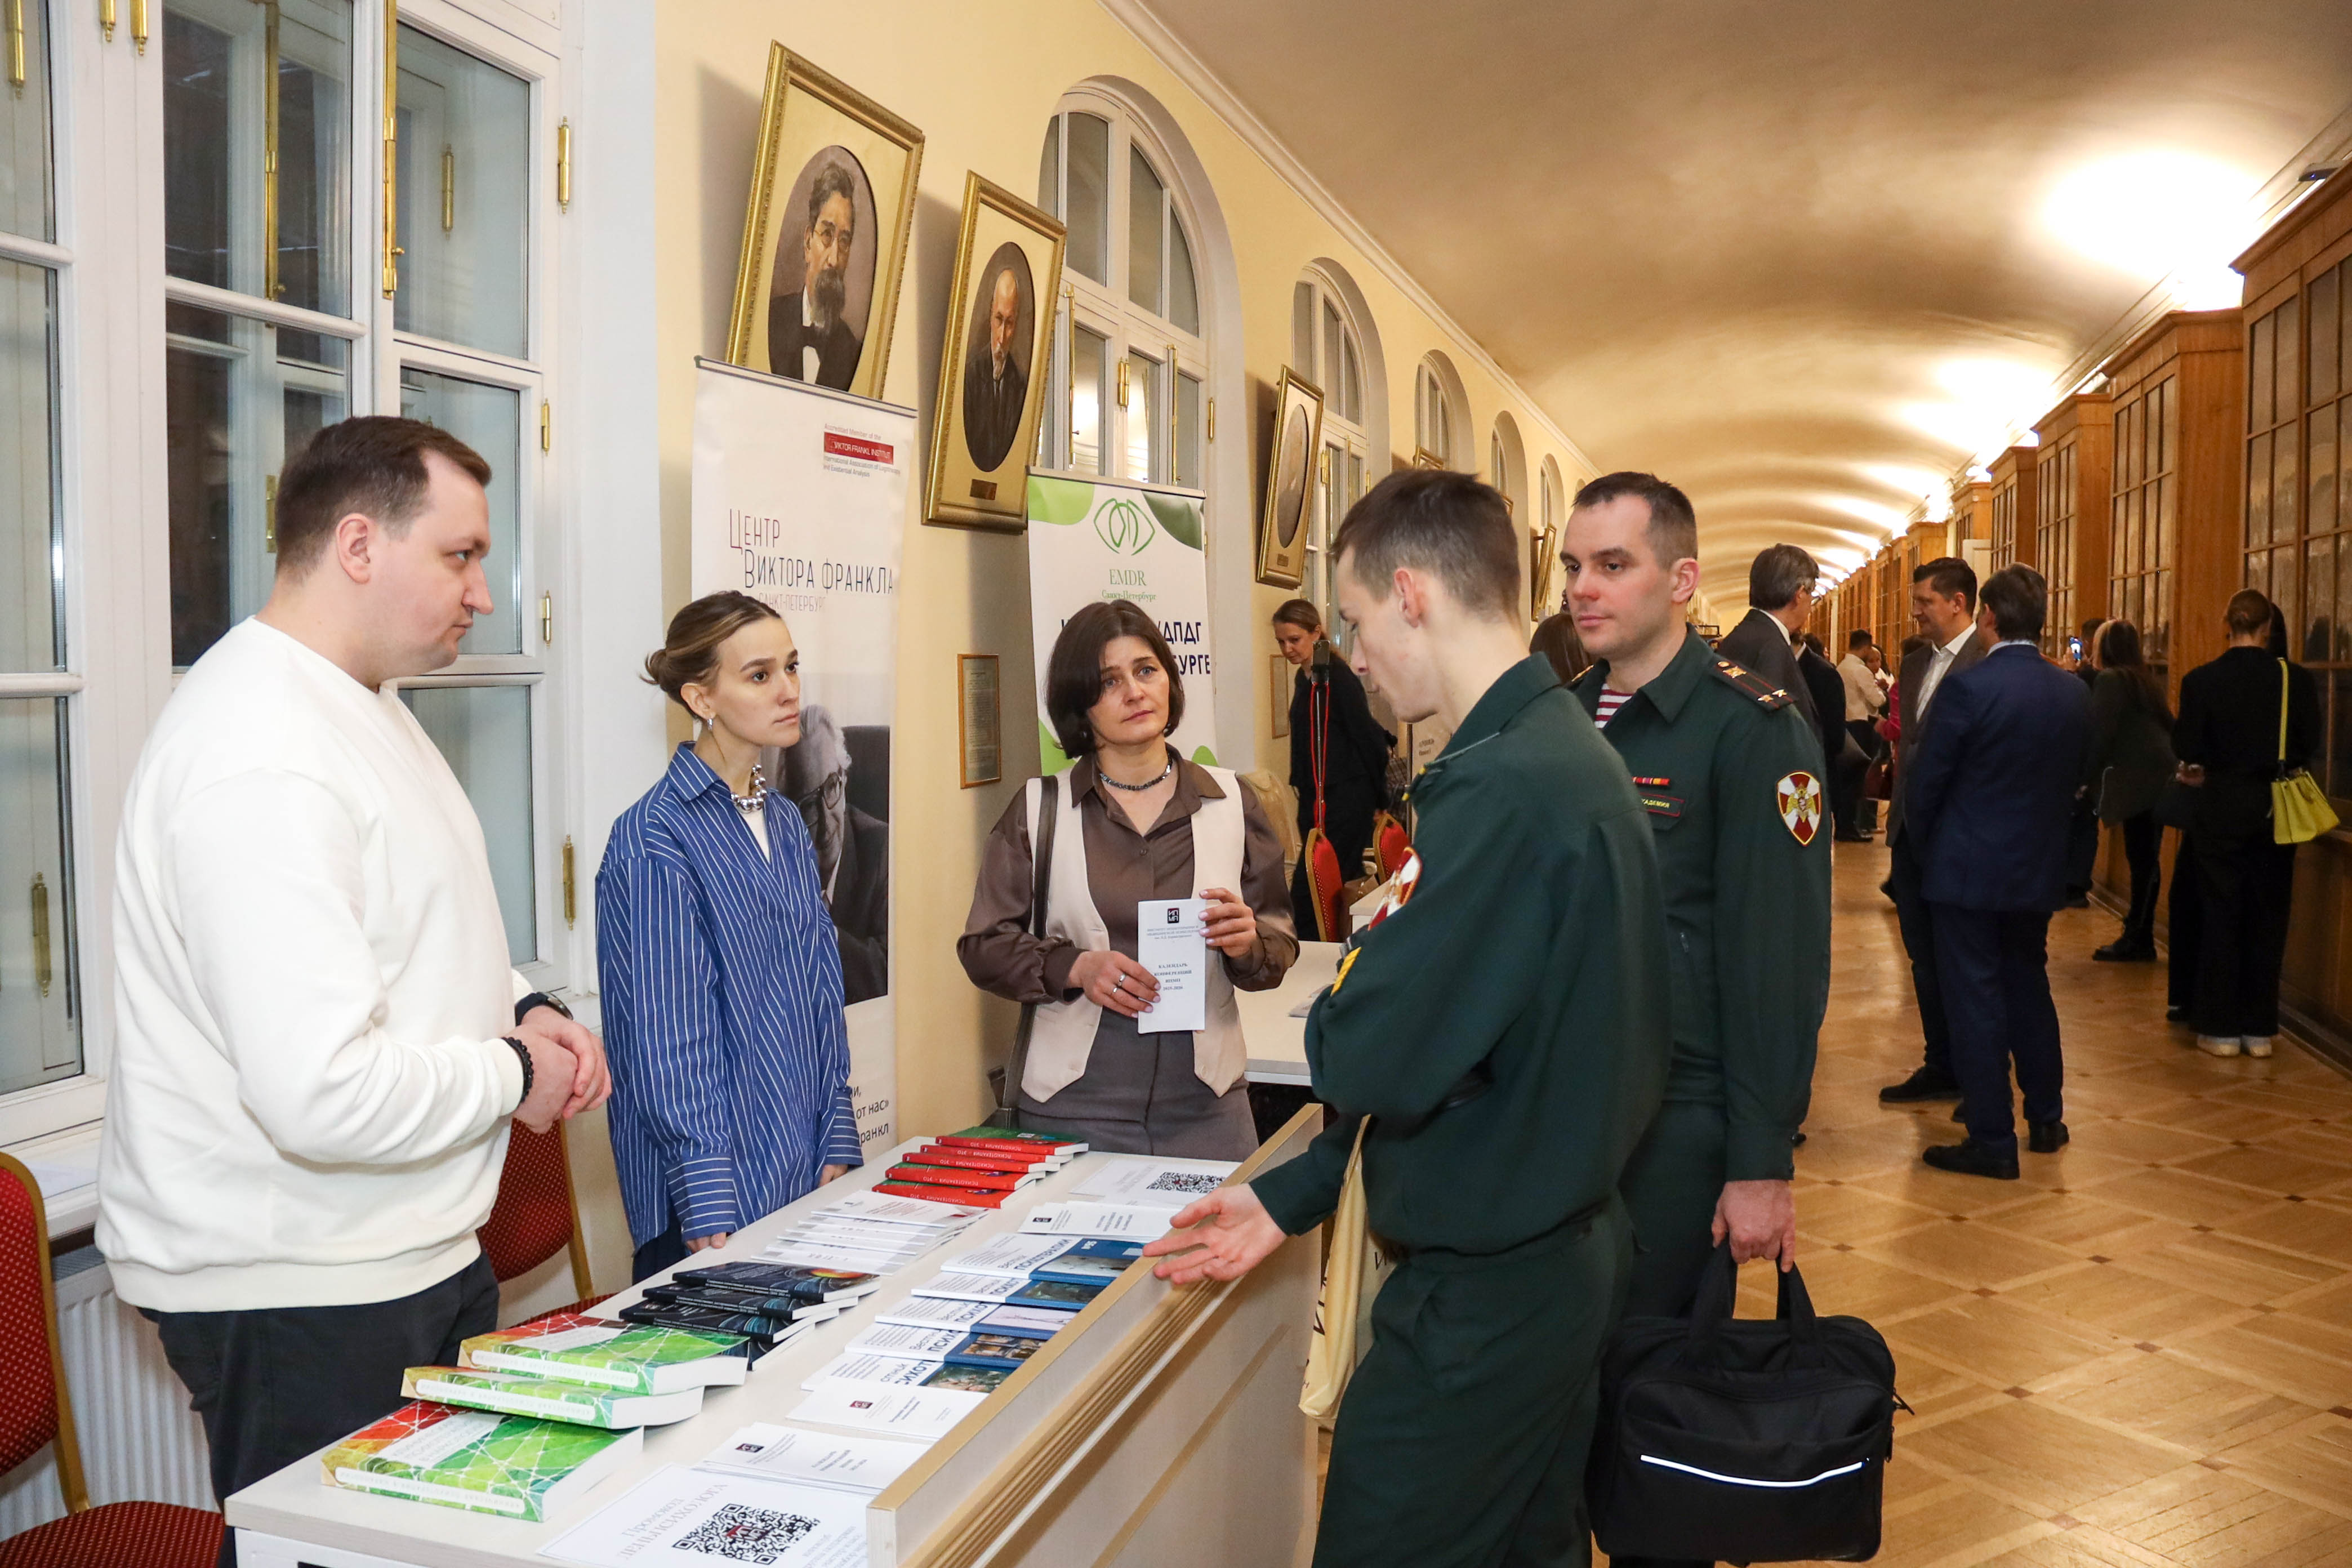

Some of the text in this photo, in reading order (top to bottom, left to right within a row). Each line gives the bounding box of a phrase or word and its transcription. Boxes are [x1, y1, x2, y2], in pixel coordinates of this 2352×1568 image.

[834, 441, 890, 459] VIKTOR FRANKL INSTITUT
[729, 508, 780, 555] ЦЕНТР
[745, 549, 893, 594] ВИКТОРА ФРАНКЛА
[1109, 568, 1147, 586] EMDR
[1102, 589, 1157, 603] Санкт-Петербург
[856, 1099, 889, 1120] от нас»
[859, 1122, 889, 1147] ранкл
[939, 1178, 979, 1186] ПСИХОТЕРАПИЯ
[954, 1301, 989, 1324] ПСИХО
